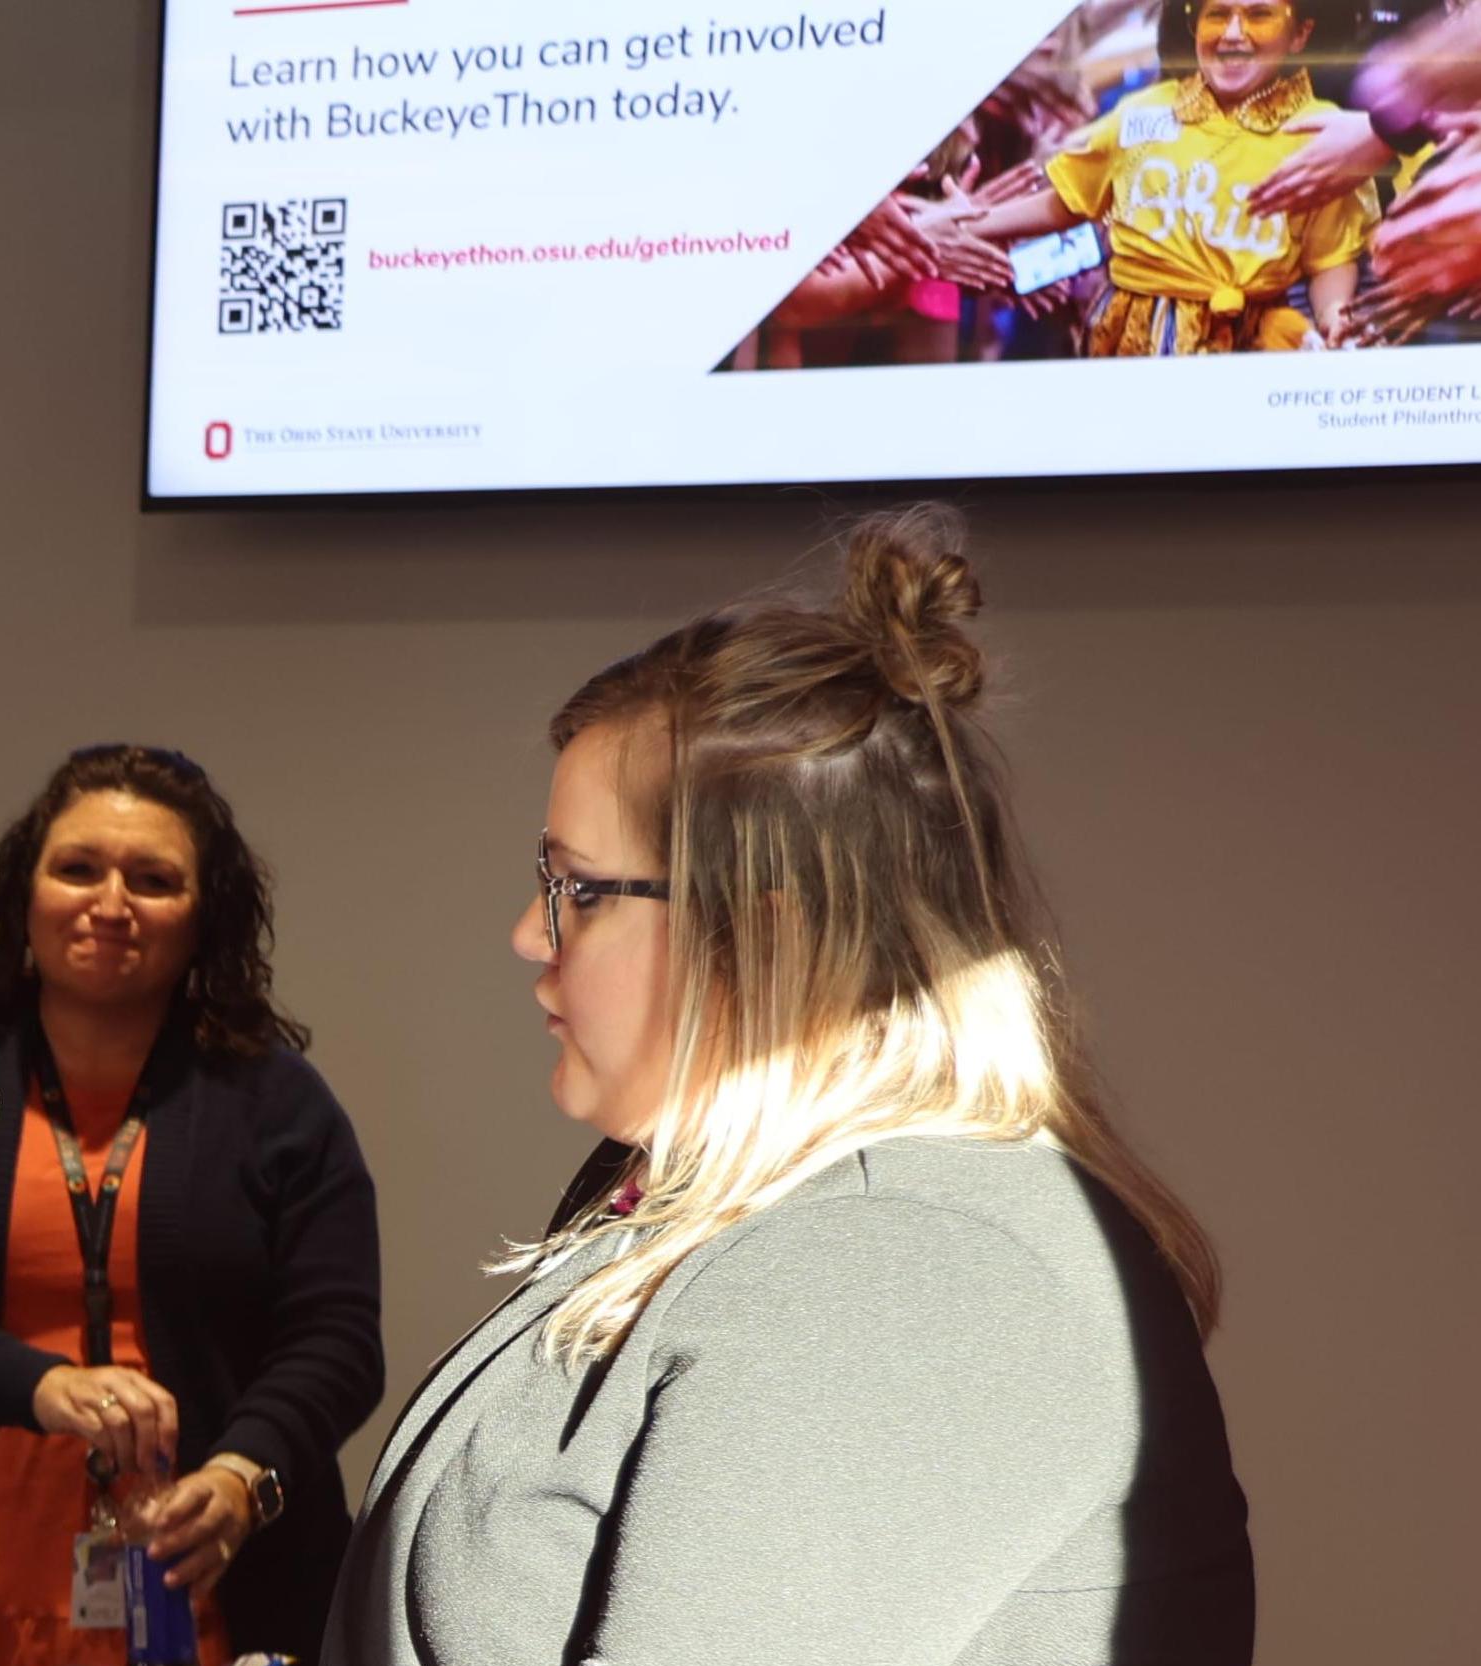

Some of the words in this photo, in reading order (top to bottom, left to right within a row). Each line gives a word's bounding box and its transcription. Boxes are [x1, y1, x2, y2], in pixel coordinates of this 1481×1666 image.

[230, 54, 336, 87] Learn
[353, 45, 438, 80] how
[453, 45, 523, 81] you
[539, 37, 608, 67] can
[625, 26, 692, 70] get
[708, 8, 885, 55] involved
[227, 106, 310, 143] with
[328, 91, 596, 139] BuckeyeThon
[613, 81, 738, 123] today.
[369, 229, 790, 270] buckeyethon.osu.edu/getinvolved
[1268, 390, 1333, 407] OFFICE
[1341, 388, 1368, 405] OF
[1373, 385, 1465, 403] STUDENT
[1318, 412, 1387, 429] Student
[1393, 408, 1481, 426] Philanthro
